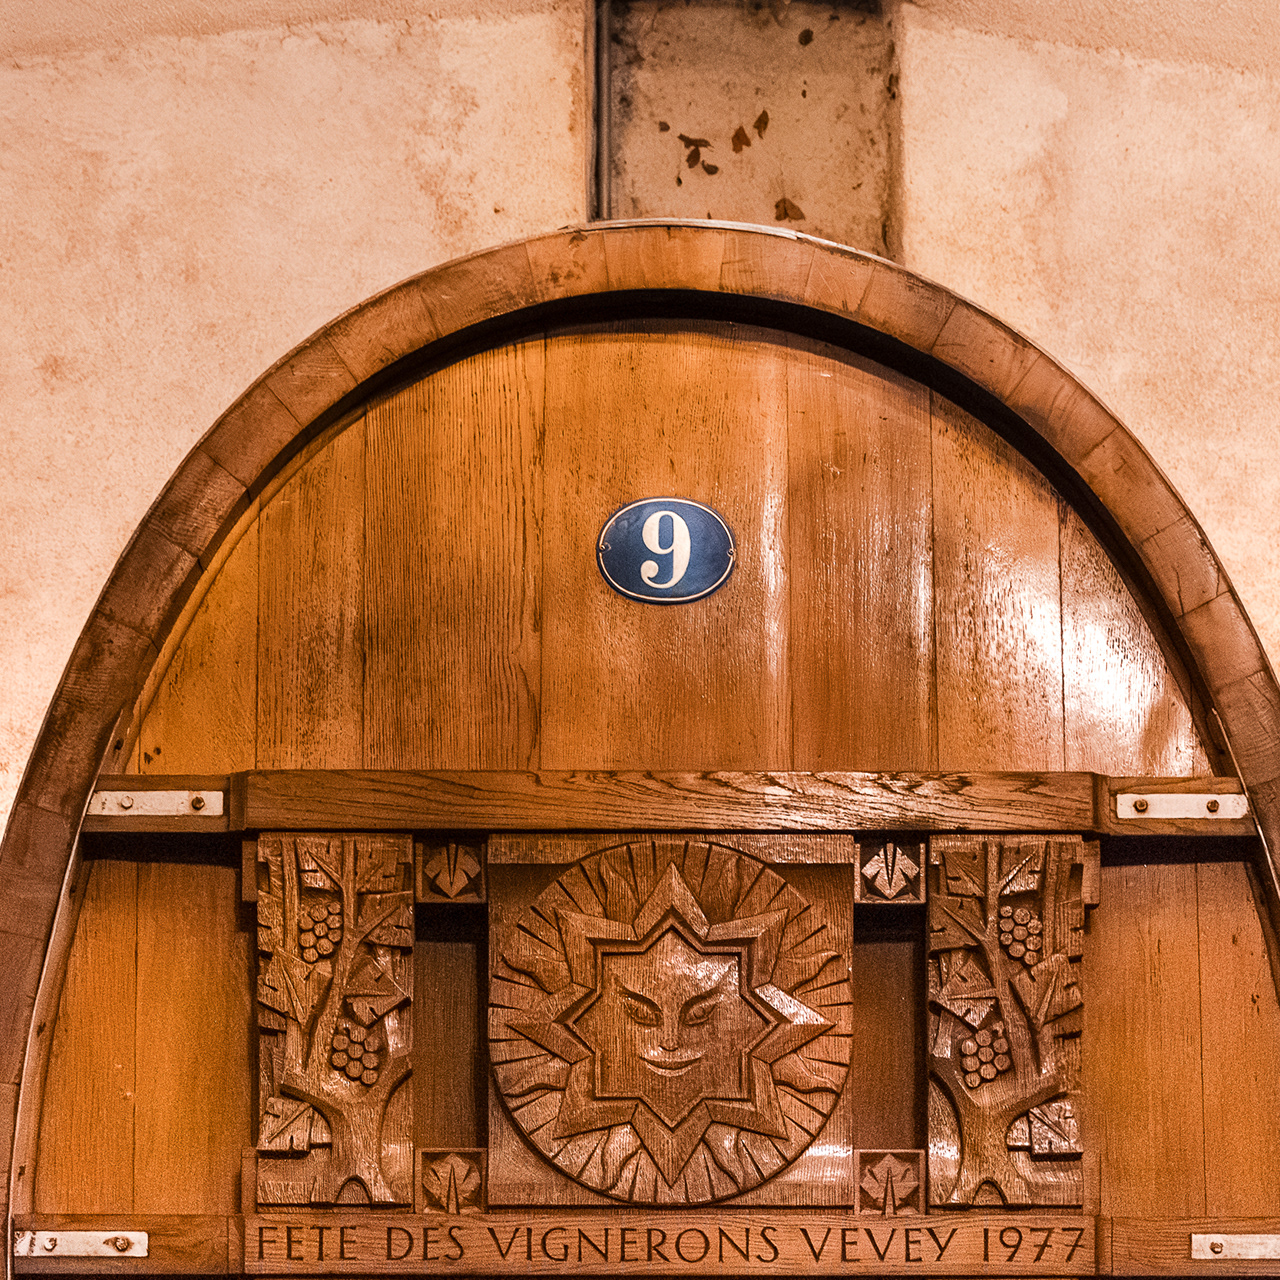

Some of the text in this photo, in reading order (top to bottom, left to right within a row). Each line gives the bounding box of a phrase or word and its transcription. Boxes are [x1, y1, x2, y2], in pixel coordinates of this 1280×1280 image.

[640, 510, 692, 589] 9
[257, 1225, 1087, 1264] FETE DES VIGNERONS VEVEY 1977
